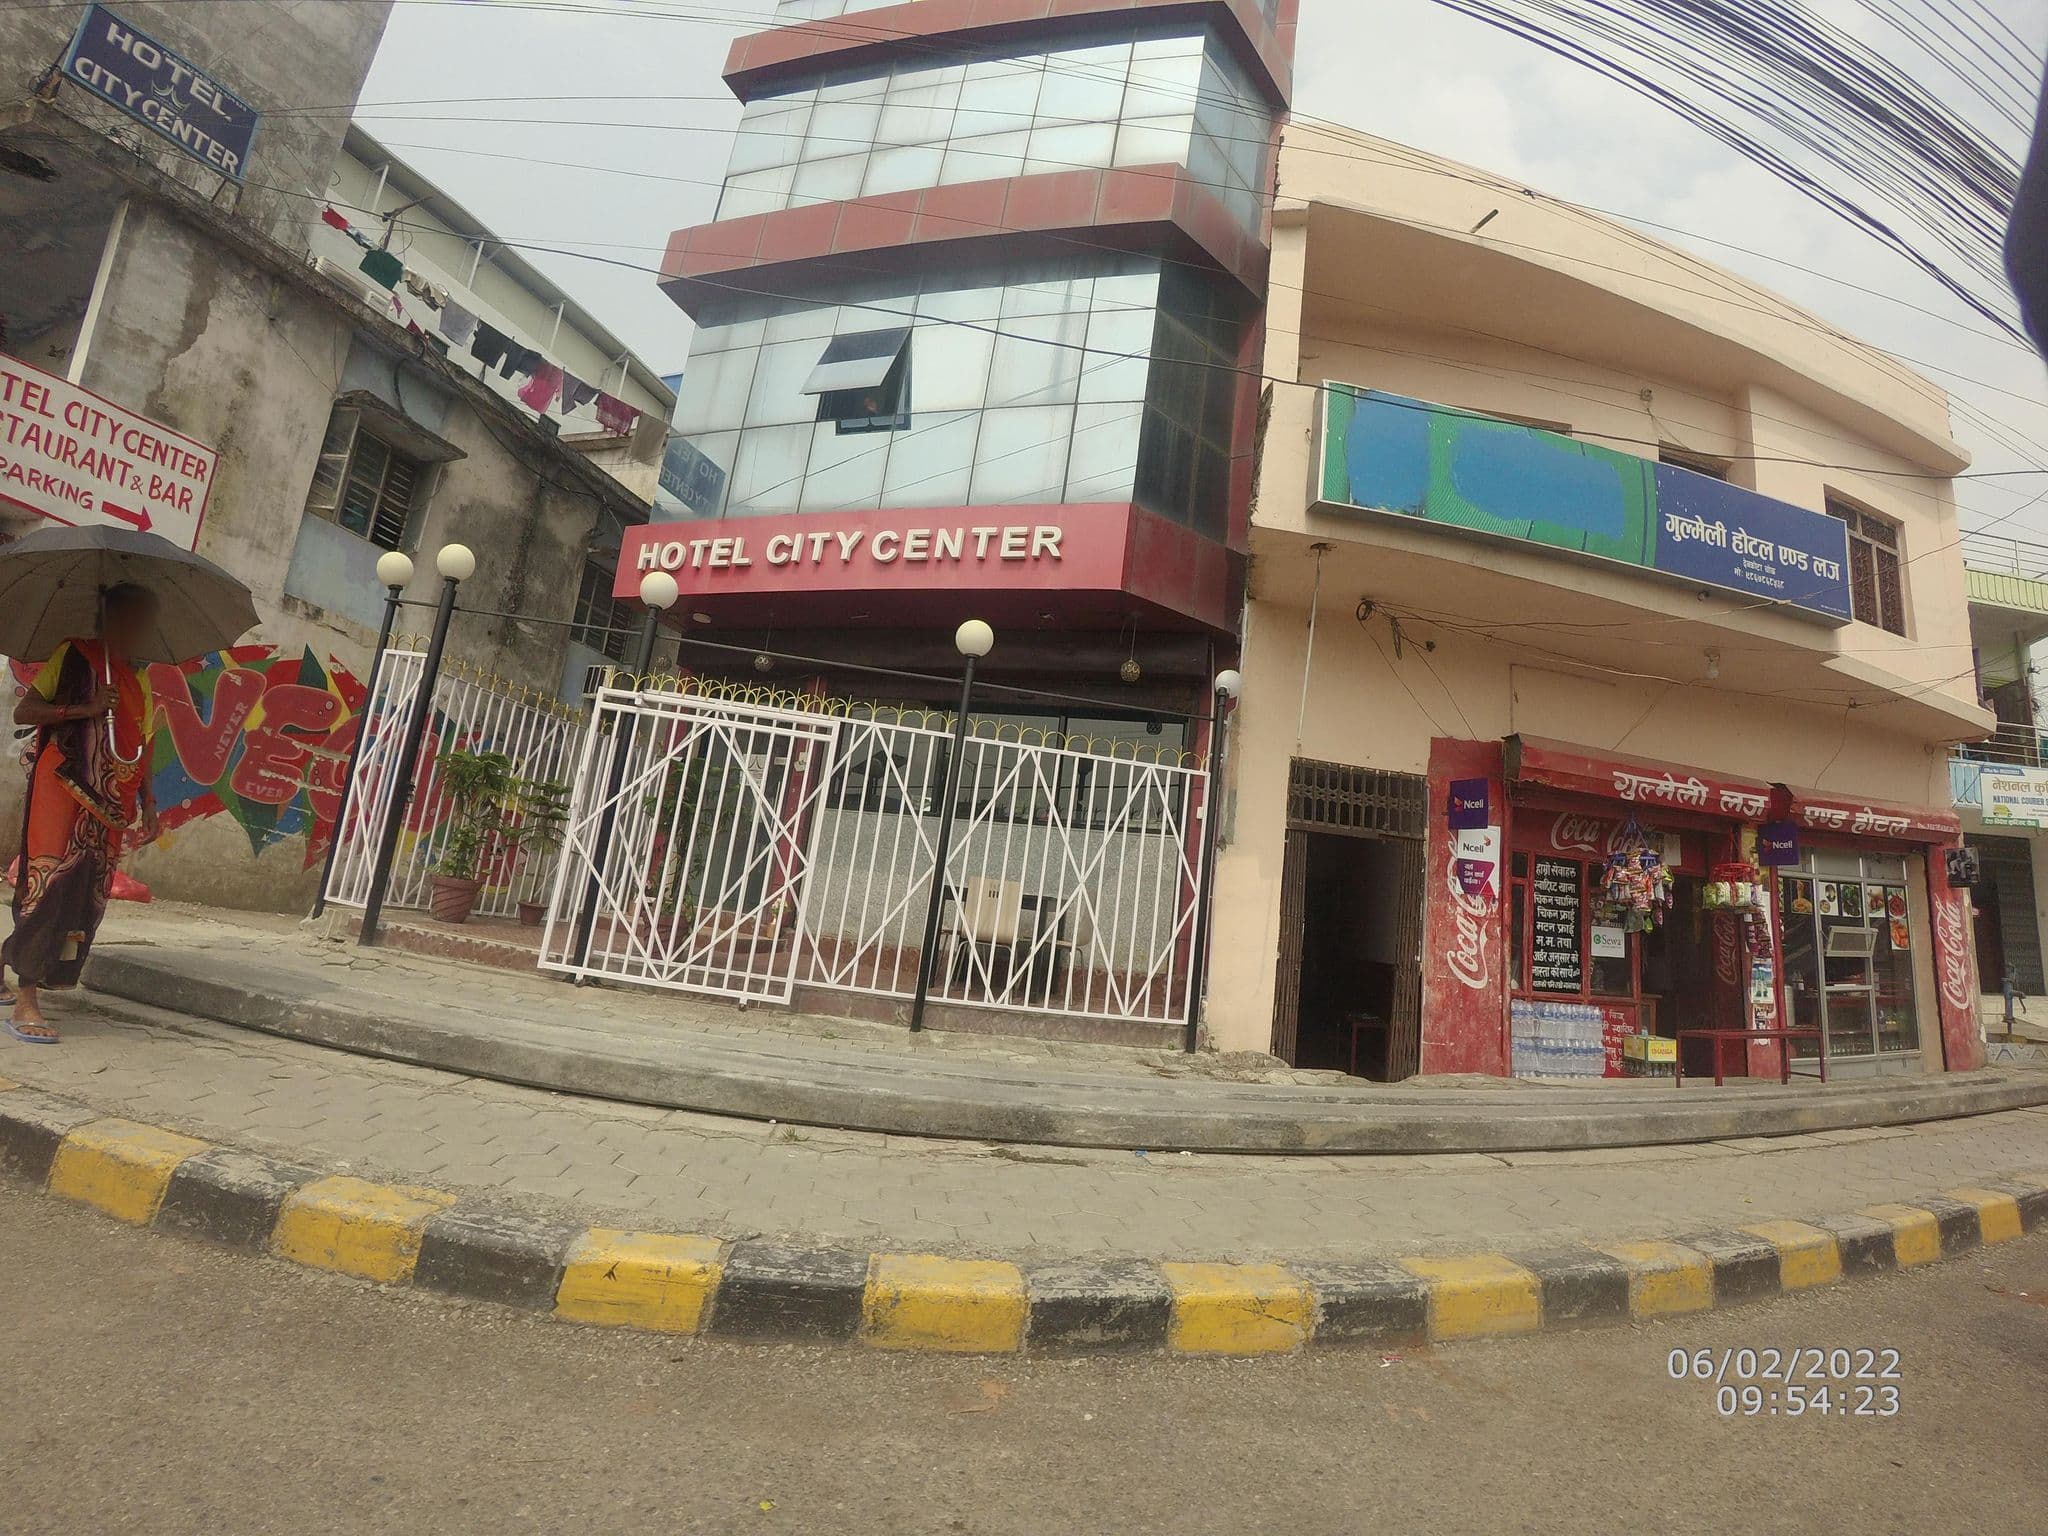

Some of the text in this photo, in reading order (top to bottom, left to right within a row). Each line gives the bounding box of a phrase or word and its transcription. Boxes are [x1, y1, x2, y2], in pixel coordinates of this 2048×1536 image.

[106, 22, 232, 123] HOTEL
[75, 57, 239, 175] CITY CENTER
[64, 401, 123, 445] CITY
[123, 430, 207, 482] CENTER
[129, 475, 144, 495] &
[148, 474, 193, 514] BAR
[637, 526, 1063, 571] HOTEL CITY CENTER
[1665, 513, 1840, 581] गुल्मेली होटल एण्ड लज
[214, 701, 250, 761] NEVER
[244, 781, 284, 799] EVER
[1613, 771, 1769, 816] गुल्मेली लज
[1992, 777, 2031, 792] नेशनल
[1463, 799, 1484, 810] Ncell
[1992, 795, 2020, 804] NATIONAL
[1804, 806, 1850, 829] एण्ड
[1851, 807, 1911, 837] होटल
[1463, 842, 1484, 853] Ncell
[1772, 840, 1793, 849] Ncell
[1558, 882, 1576, 894] खाना
[1537, 906, 1558, 919] चिकन
[1536, 921, 1555, 932] मटन
